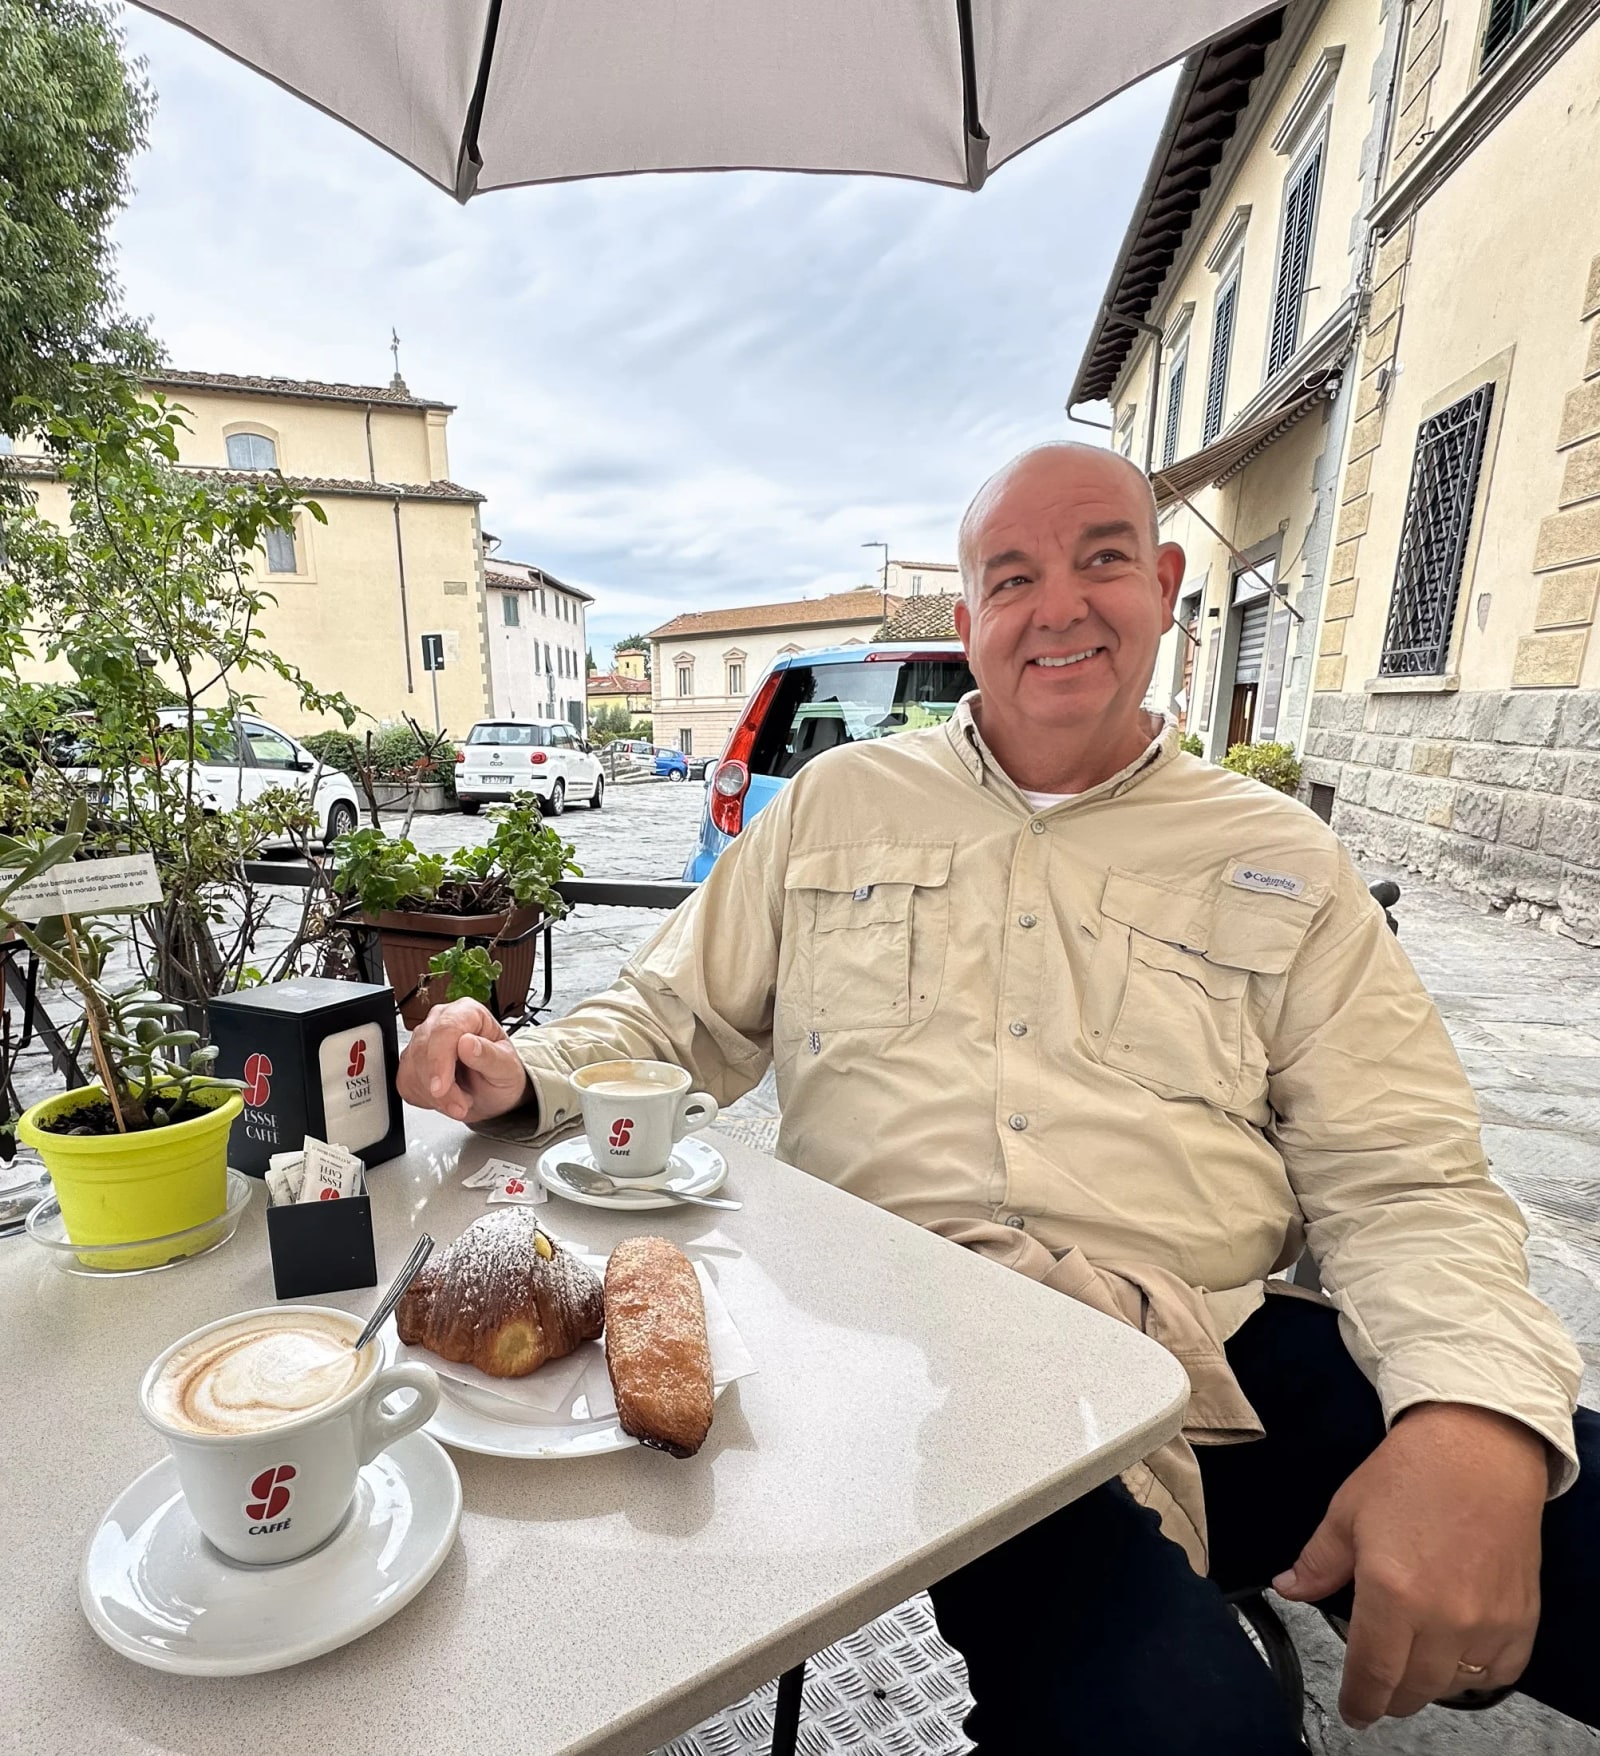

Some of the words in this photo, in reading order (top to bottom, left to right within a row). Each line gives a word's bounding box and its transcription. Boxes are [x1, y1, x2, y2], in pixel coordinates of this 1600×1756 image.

[50, 877, 76, 886] bambini
[1253, 873, 1296, 888] Columbia
[346, 1075, 370, 1090] ESSSE
[244, 1108, 279, 1129] ESSSE
[320, 1174, 342, 1189] ESSSE
[248, 1518, 292, 1535] CAFFÈ
